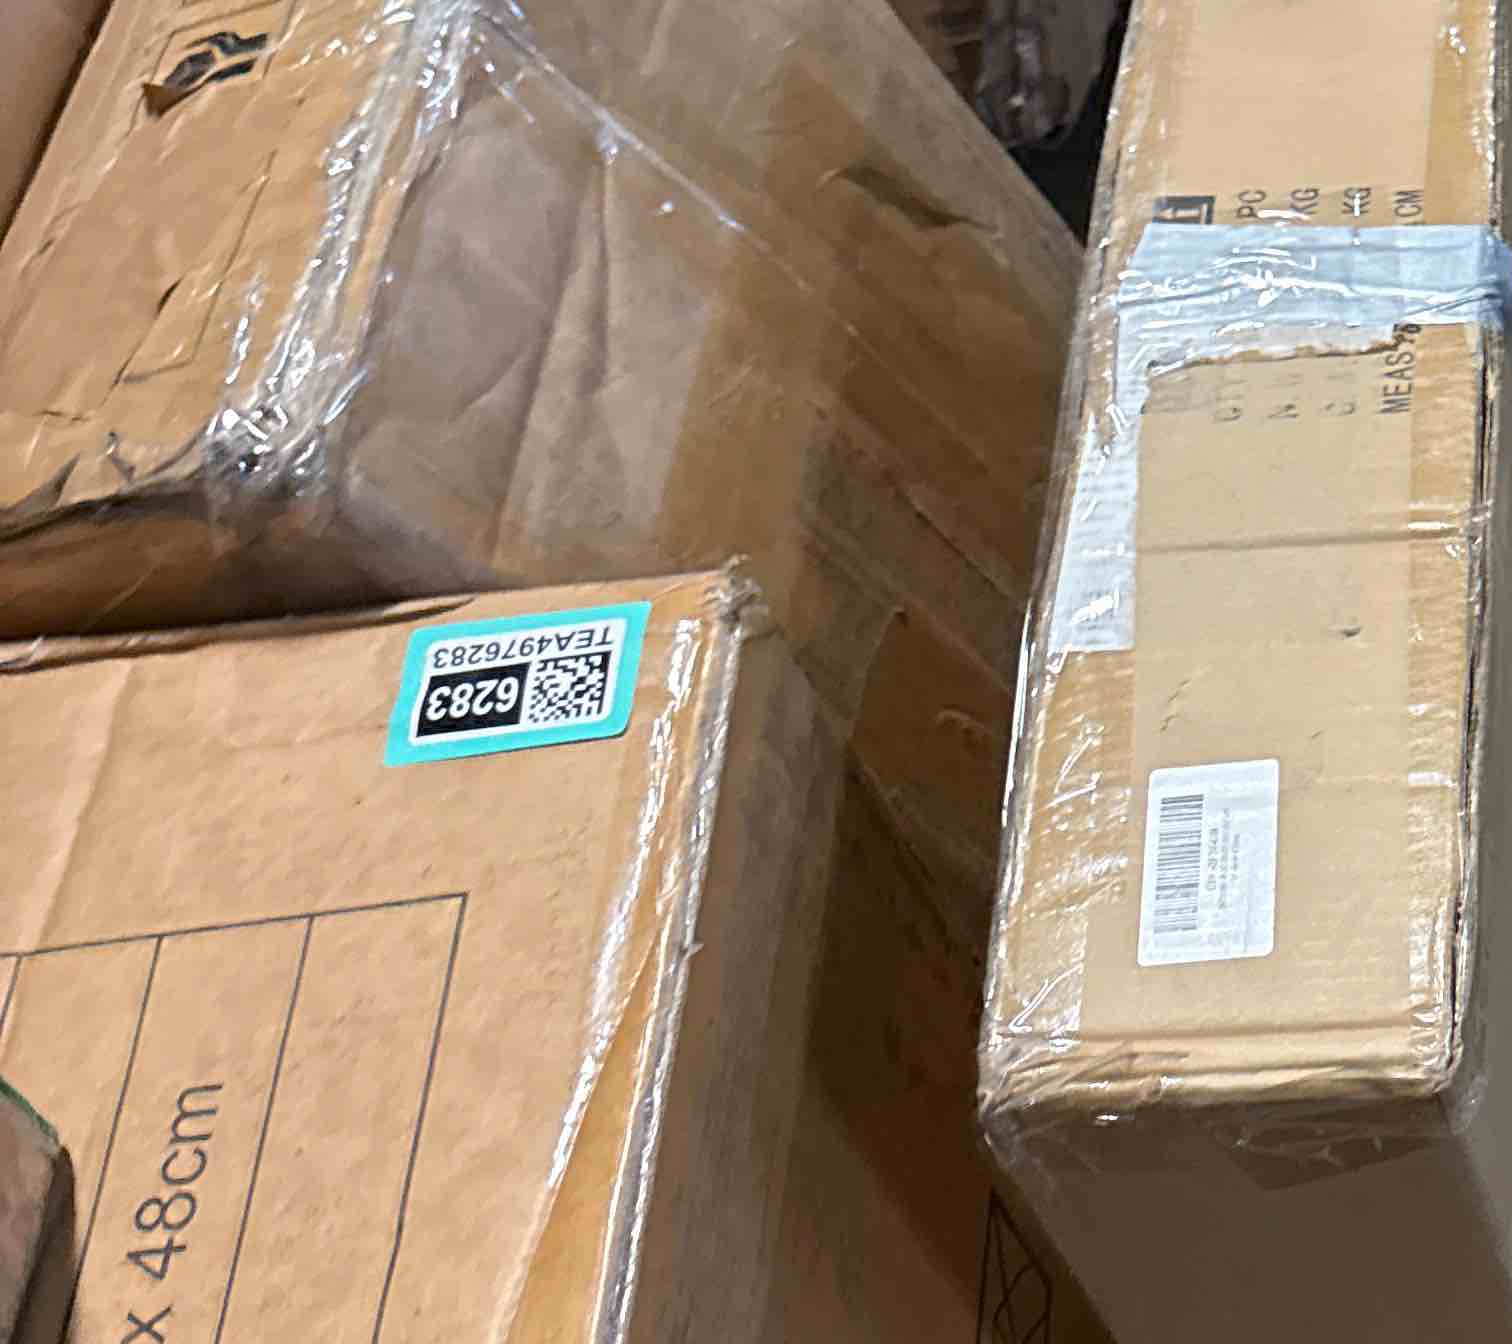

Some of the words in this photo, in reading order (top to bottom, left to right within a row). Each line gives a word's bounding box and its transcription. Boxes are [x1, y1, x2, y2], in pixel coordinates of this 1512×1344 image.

[1235, 189, 1266, 219] PC
[1288, 188, 1321, 216] KG
[1394, 189, 1424, 219] CM
[432, 626, 612, 669] TEA4976283
[425, 675, 520, 721] 6283
[128, 1080, 226, 1283] 48cm
